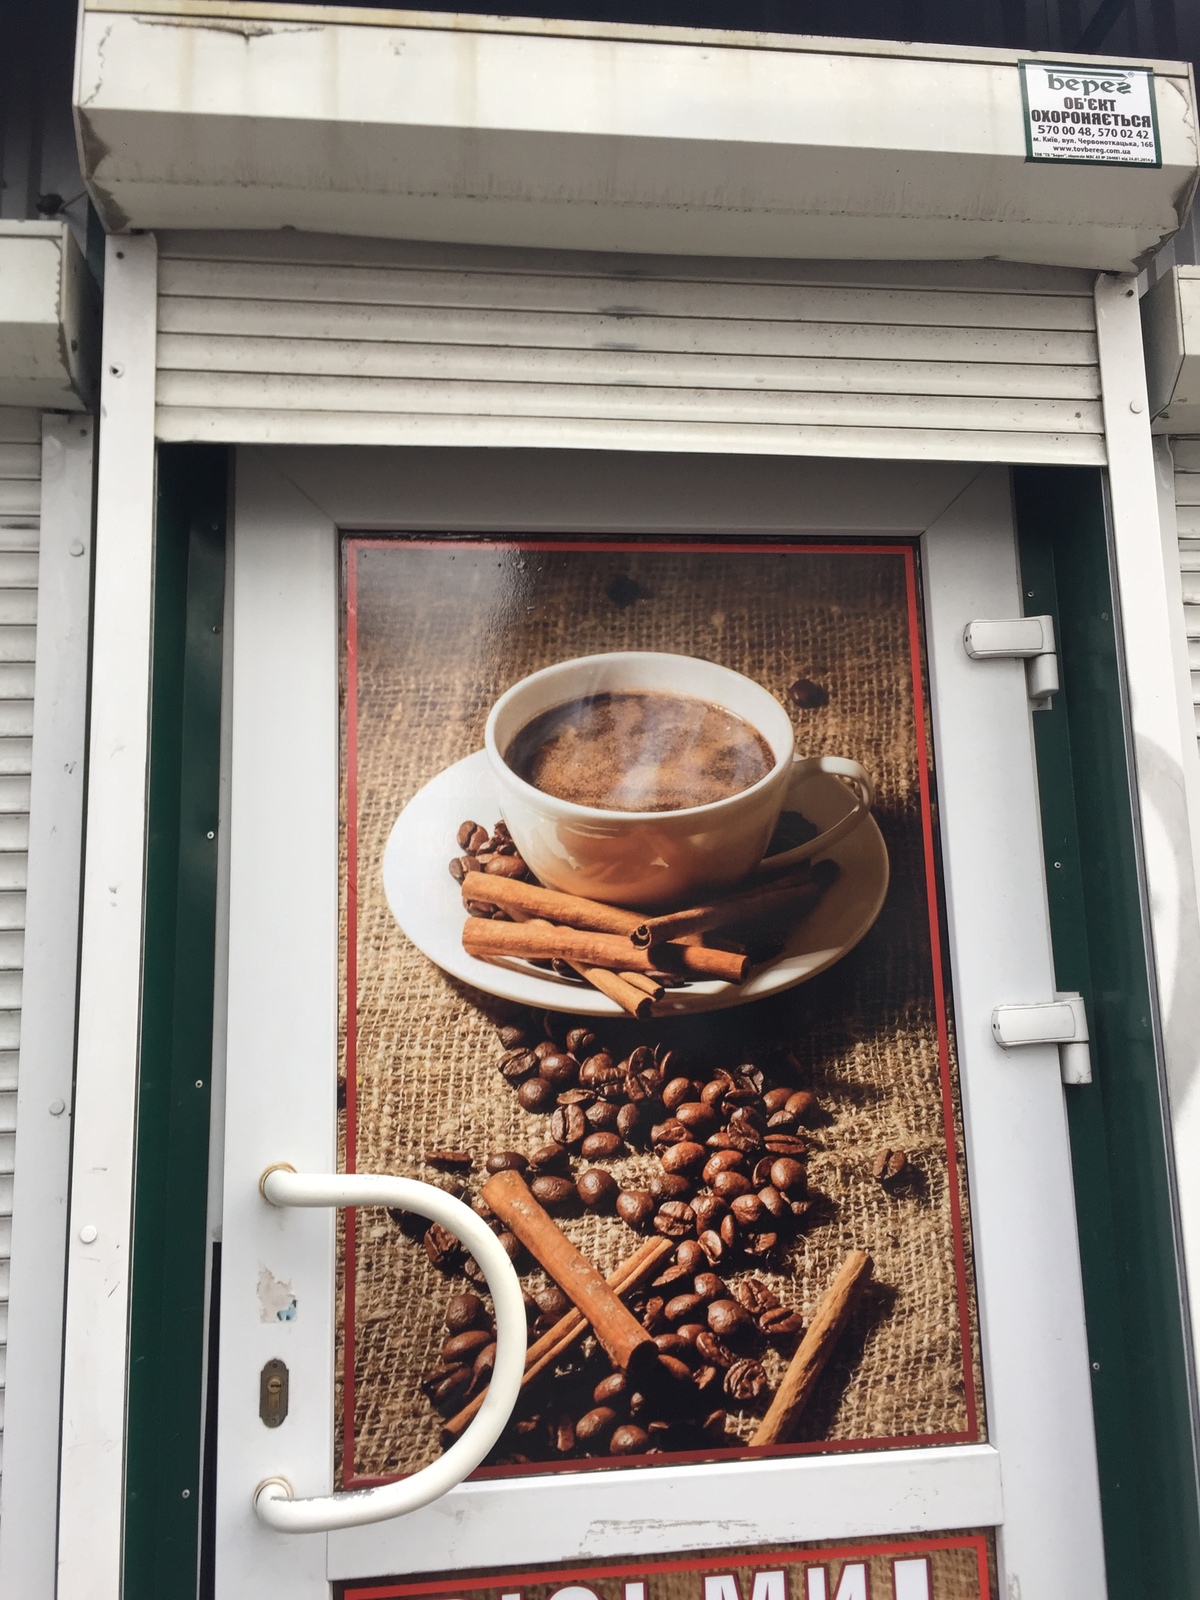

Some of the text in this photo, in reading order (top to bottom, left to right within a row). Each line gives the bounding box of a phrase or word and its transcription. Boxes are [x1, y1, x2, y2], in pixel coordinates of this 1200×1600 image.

[1063, 96, 1116, 112] ОБ'ЄКТ
[1031, 109, 1151, 128] ОХОРОНЯЄТЬСЯ
[1037, 124, 1150, 140] 570 00 48, 570 02 42
[1042, 136, 1060, 144] Київ,
[1053, 145, 1131, 155] www.tovbereg.com.ua
